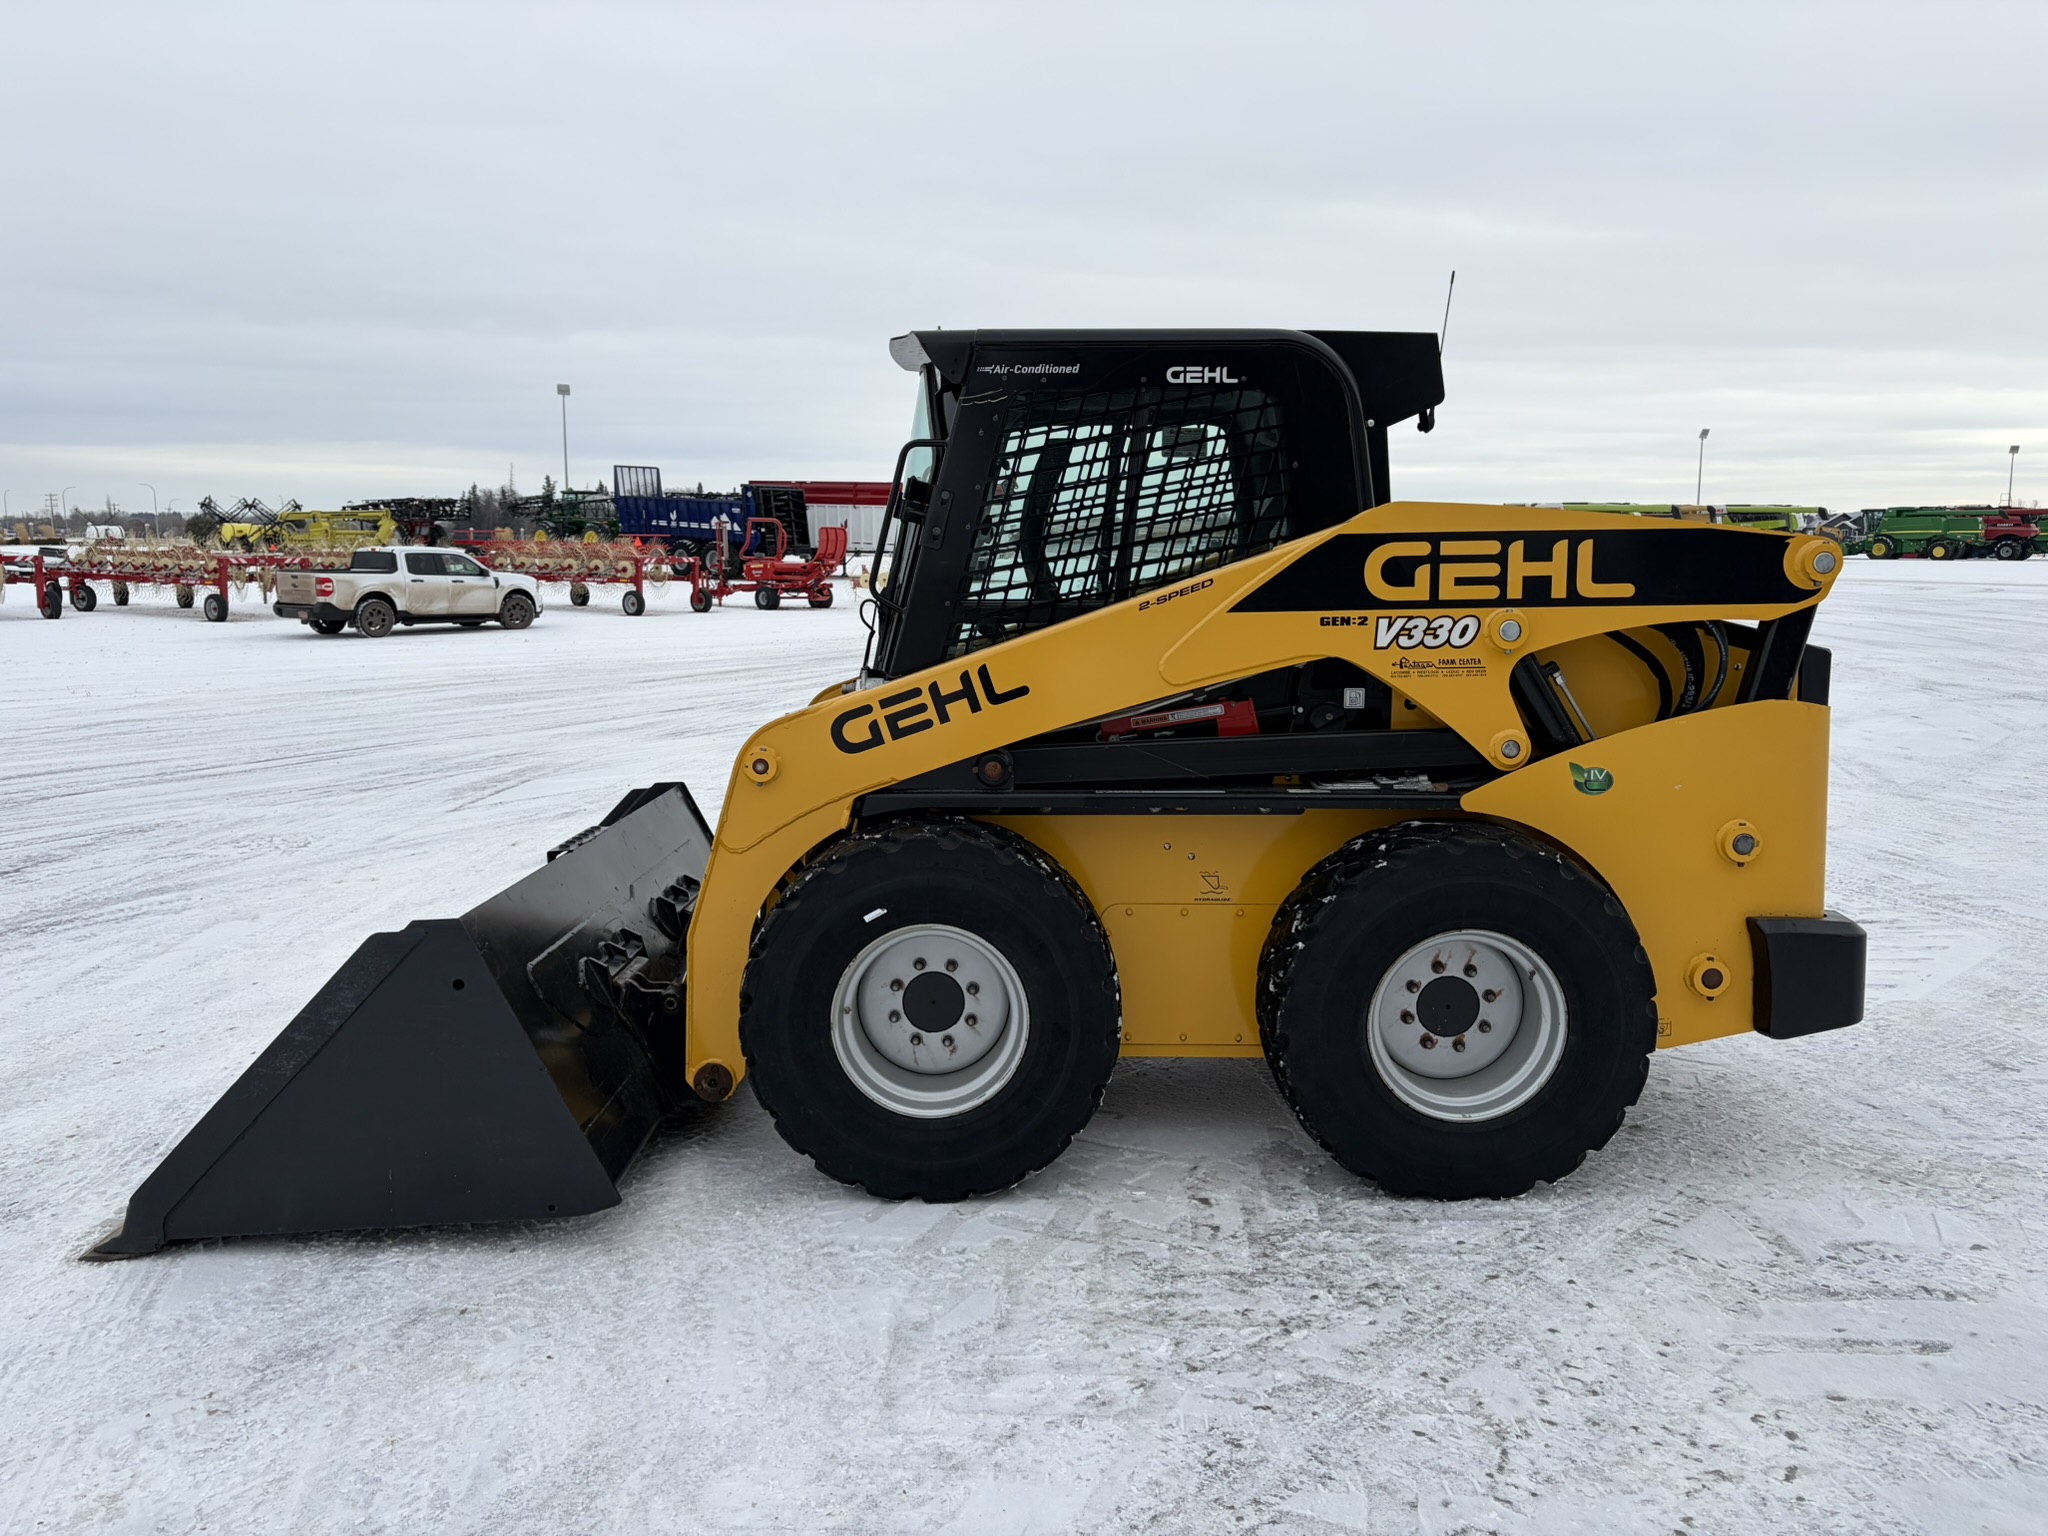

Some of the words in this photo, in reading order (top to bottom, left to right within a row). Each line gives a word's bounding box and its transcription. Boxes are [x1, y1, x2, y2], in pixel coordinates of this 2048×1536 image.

[992, 363, 1081, 374] Air-Conditioned
[1166, 365, 1239, 384] GEHL
[1364, 538, 1636, 601] GEHL
[1138, 578, 1214, 612] 2-SPEED
[1319, 616, 1369, 627] GEN:2
[1373, 614, 1481, 650] V330
[831, 663, 1030, 754] GEHL
